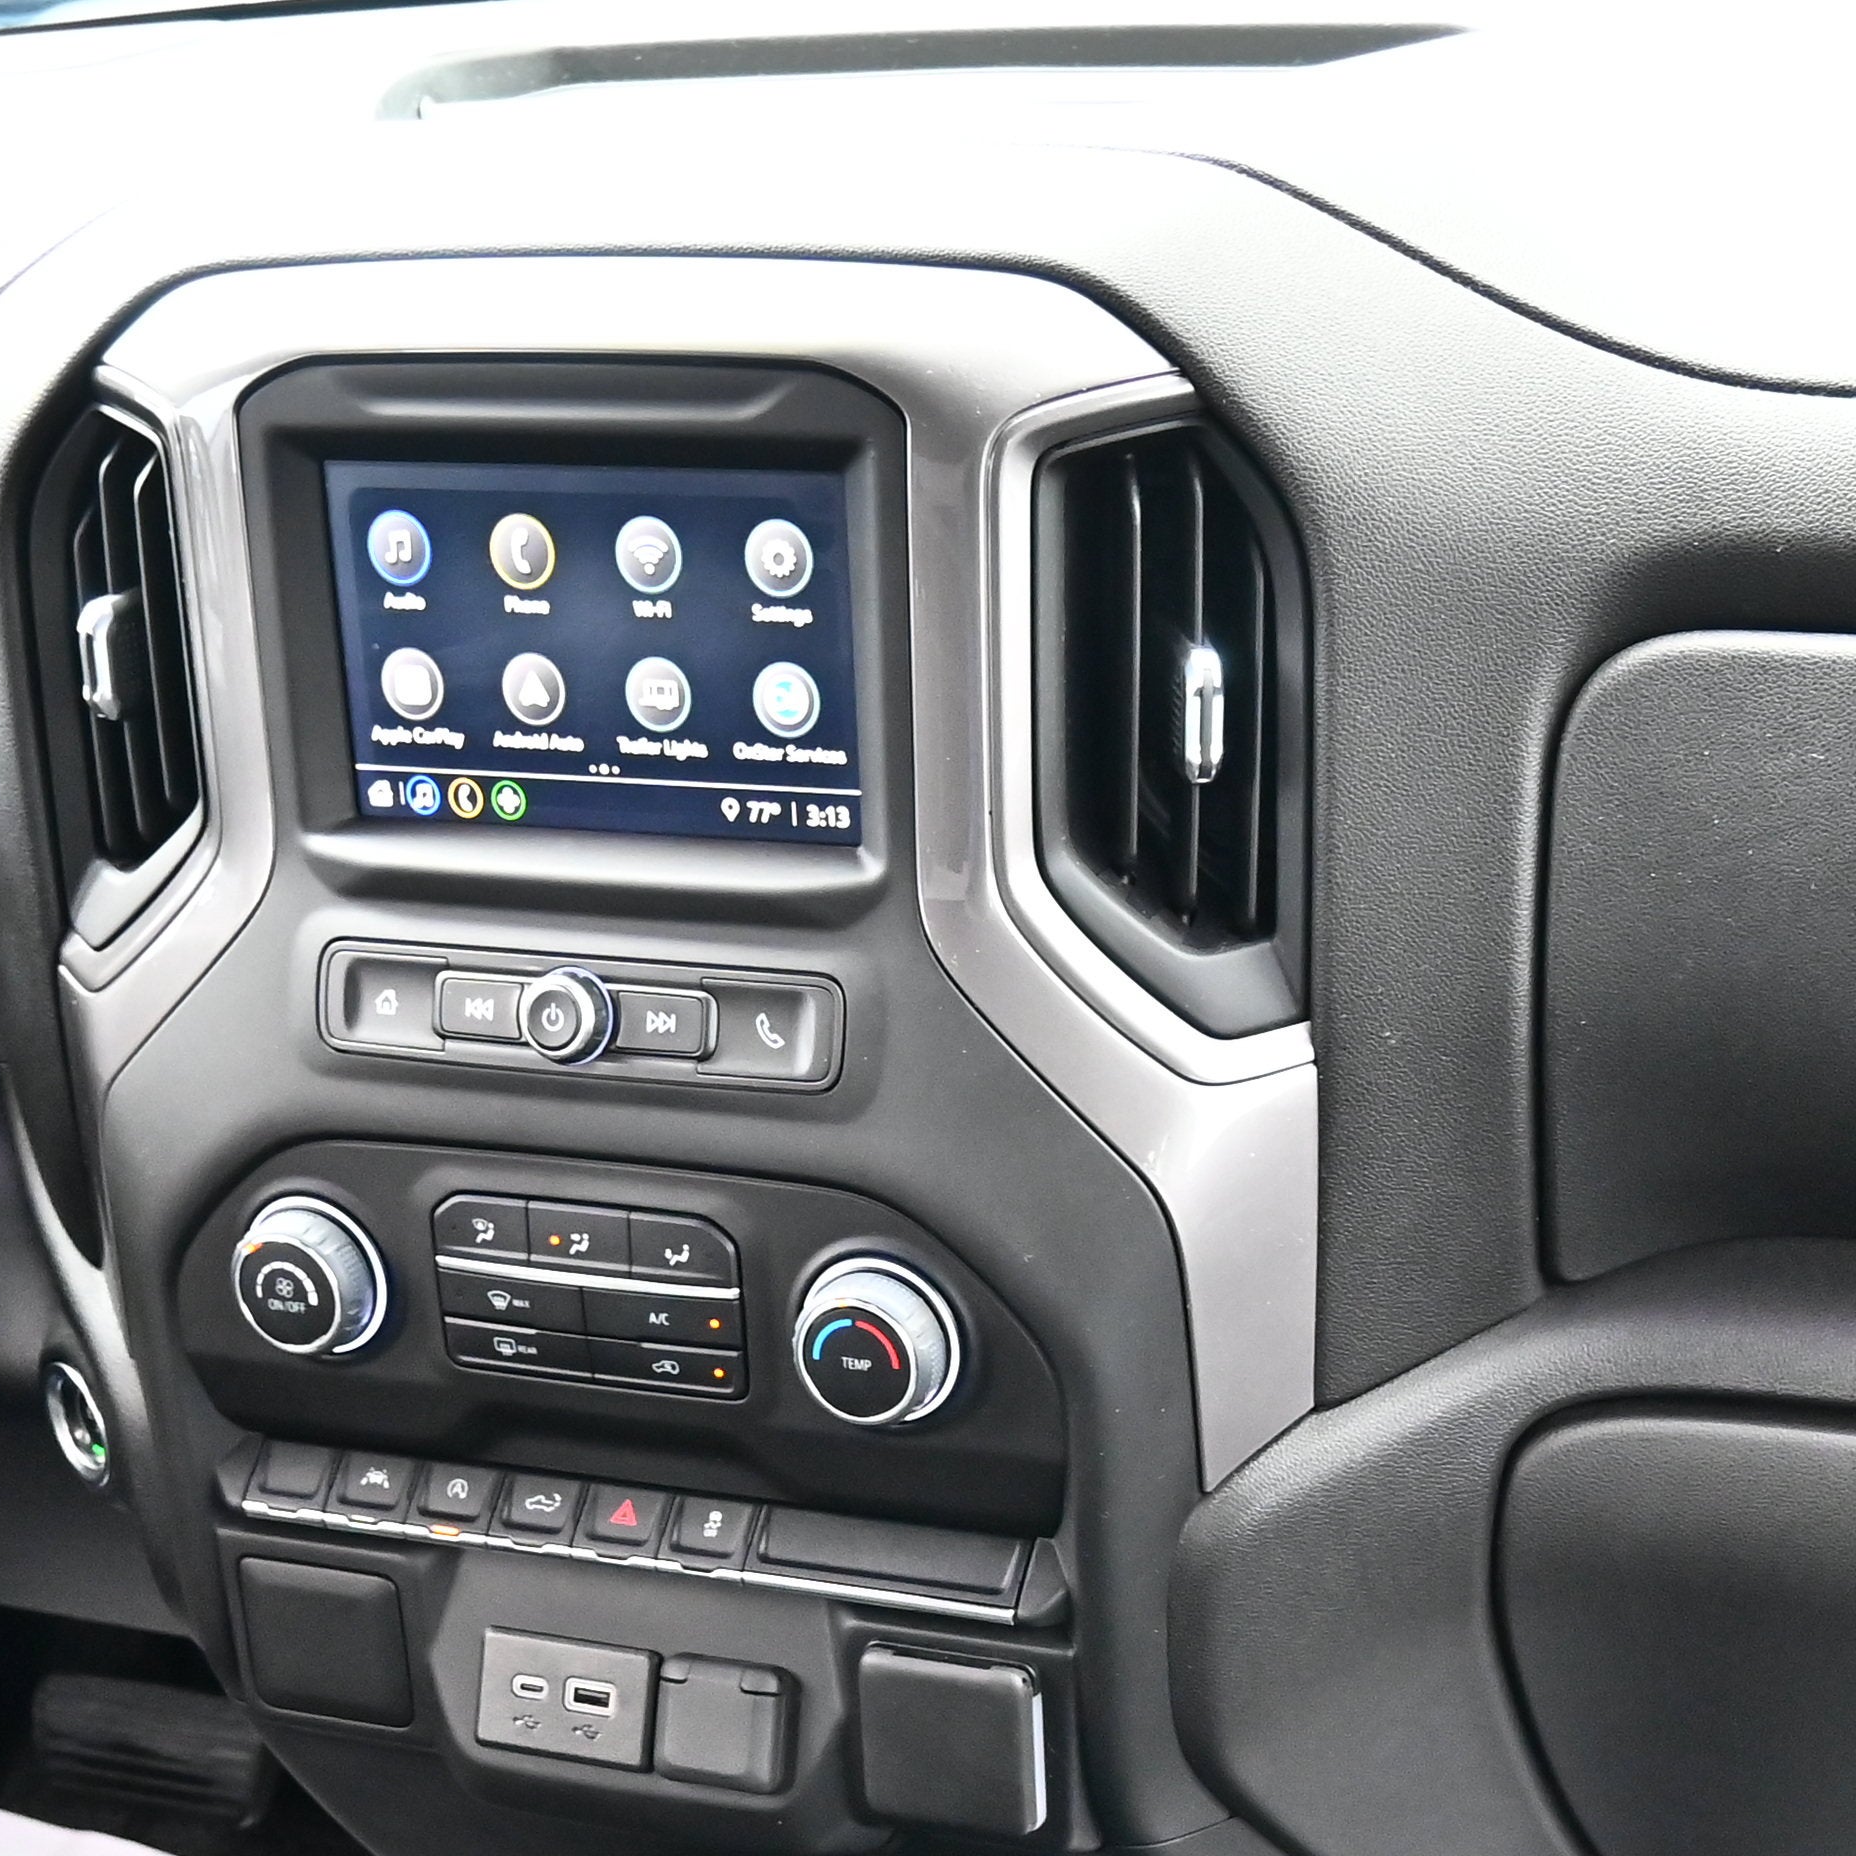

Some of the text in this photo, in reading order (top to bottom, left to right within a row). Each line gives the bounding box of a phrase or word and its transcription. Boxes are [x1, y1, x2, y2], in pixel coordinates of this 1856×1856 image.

[806, 804, 851, 829] 3:13
[267, 1298, 306, 1314] ON/OFF
[648, 1312, 670, 1326] A/C
[841, 1356, 872, 1371] TEMP
